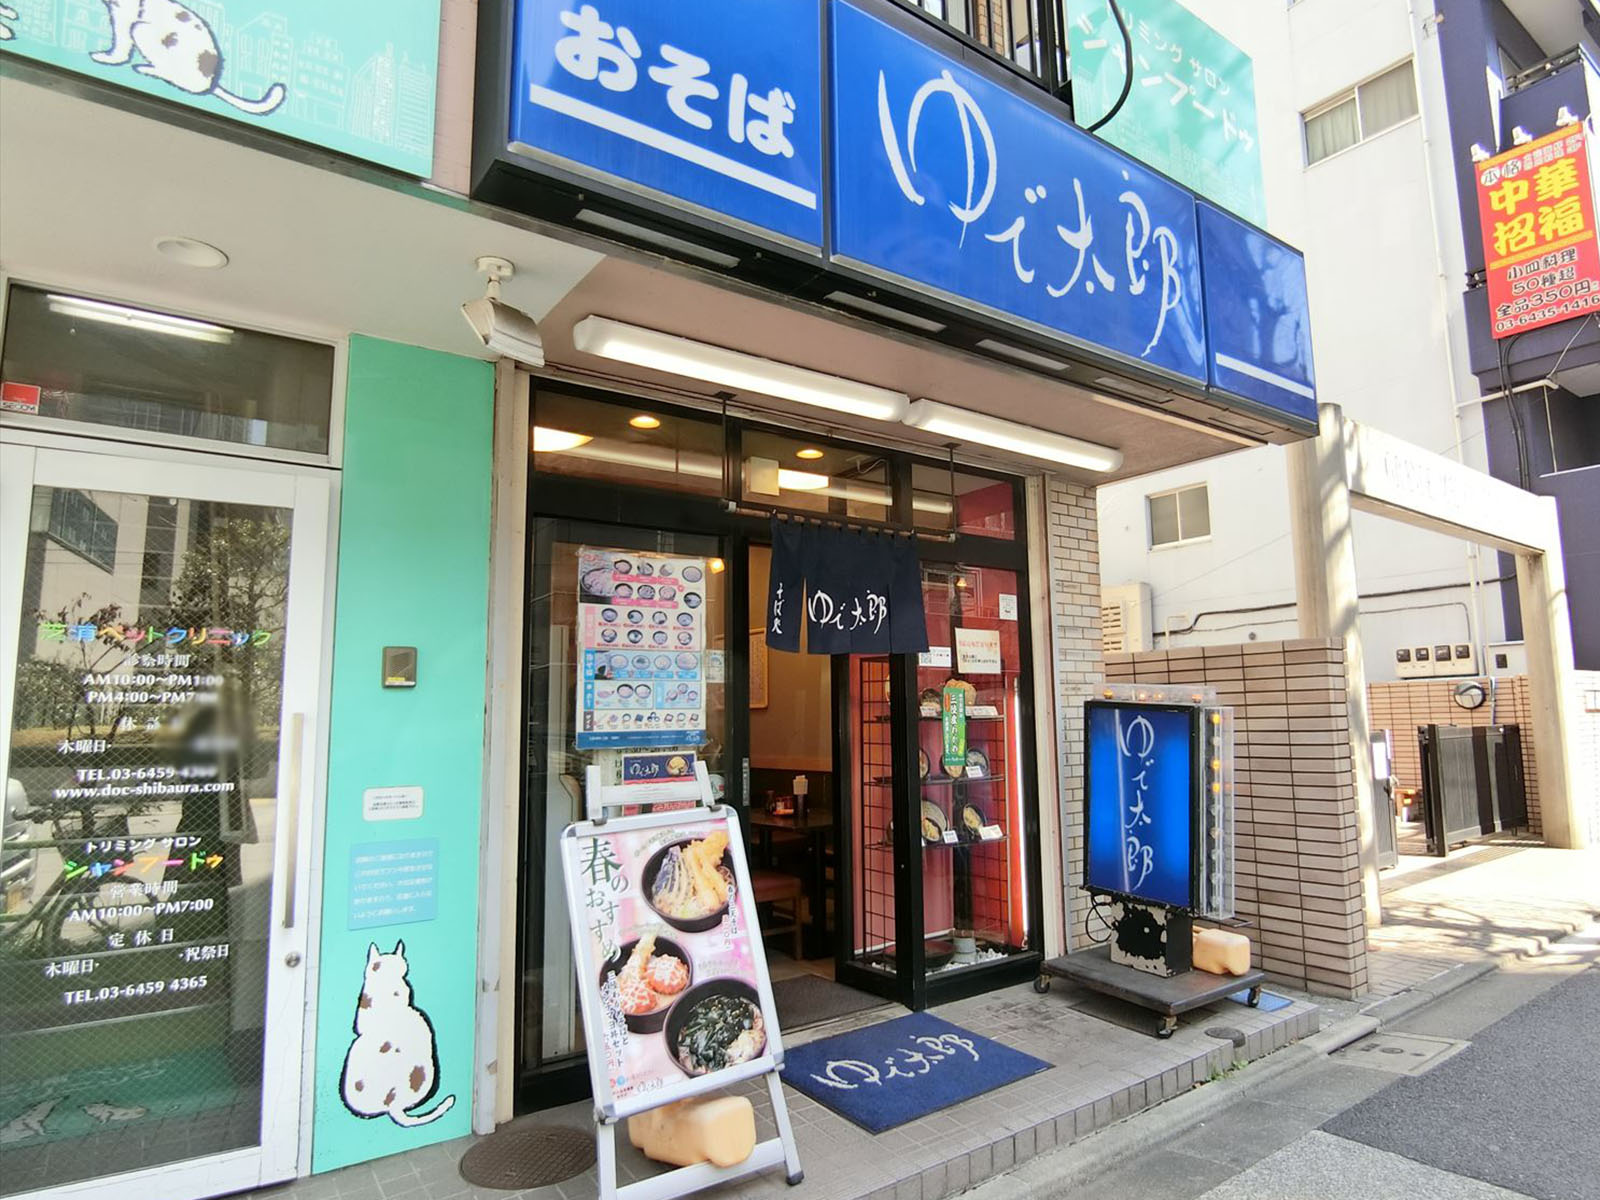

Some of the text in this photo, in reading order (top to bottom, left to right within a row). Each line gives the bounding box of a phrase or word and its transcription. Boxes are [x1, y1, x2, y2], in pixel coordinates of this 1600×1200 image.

[554, 4, 797, 158] おそば
[1189, 57, 1230, 95] サロン
[878, 69, 1184, 358] ゆで太郎
[1488, 157, 1580, 215] 中華
[1493, 194, 1585, 257] 招福
[807, 589, 888, 635] ゆで太郎
[53, 780, 236, 800] www.doc-shibaura.com
[1118, 714, 1155, 891] ゆで太郎
[86, 836, 202, 854] トリミング サロン
[110, 880, 178, 898] 営業時間
[580, 837, 629, 964] 春のおすすめ
[810, 1033, 980, 1091] ゆで太郎
